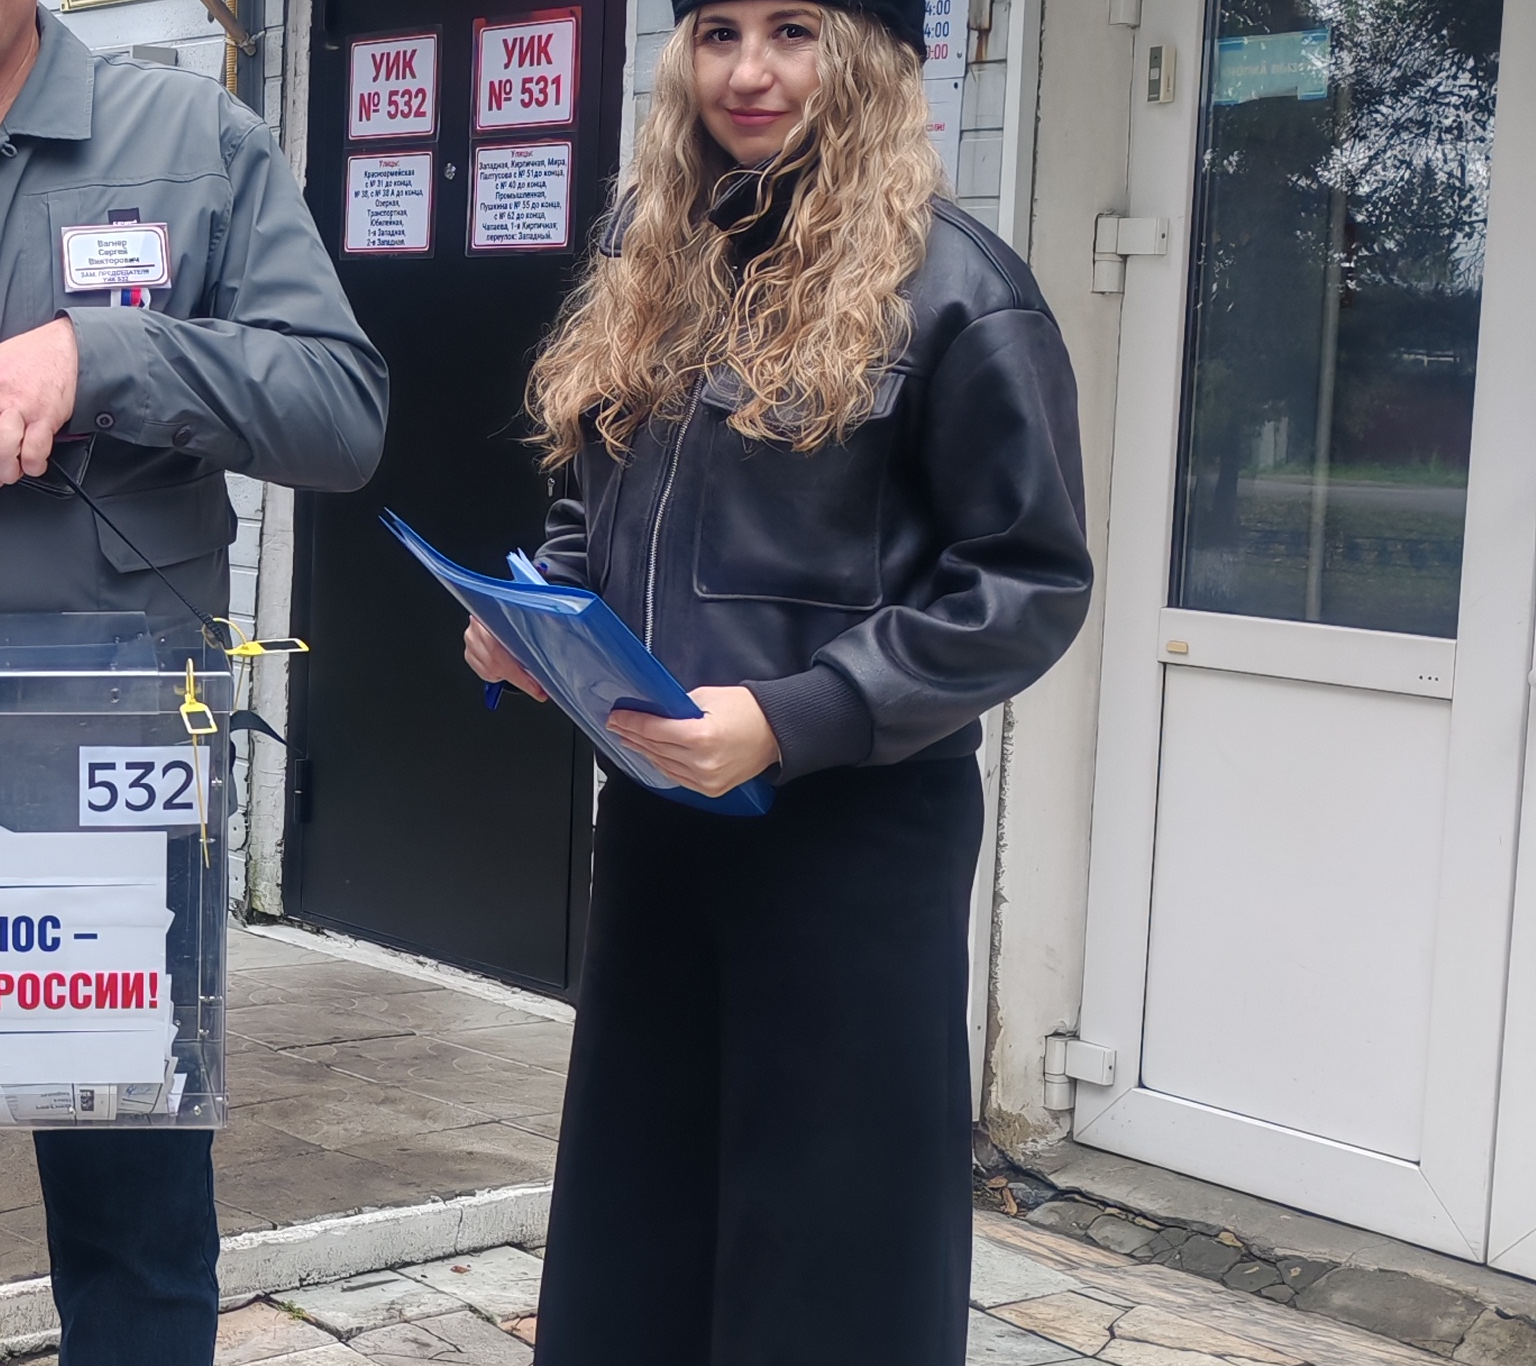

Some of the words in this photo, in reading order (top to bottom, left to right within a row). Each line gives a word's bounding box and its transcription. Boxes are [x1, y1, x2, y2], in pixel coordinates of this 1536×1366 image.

[924, 0, 951, 17] 4:00
[924, 21, 950, 39] 4:00
[370, 48, 418, 83] УИК
[502, 33, 554, 70] УИК
[358, 90, 381, 122] №
[386, 87, 427, 120] 532
[487, 78, 513, 112] №
[520, 73, 562, 109] 531
[86, 760, 194, 813] 532
